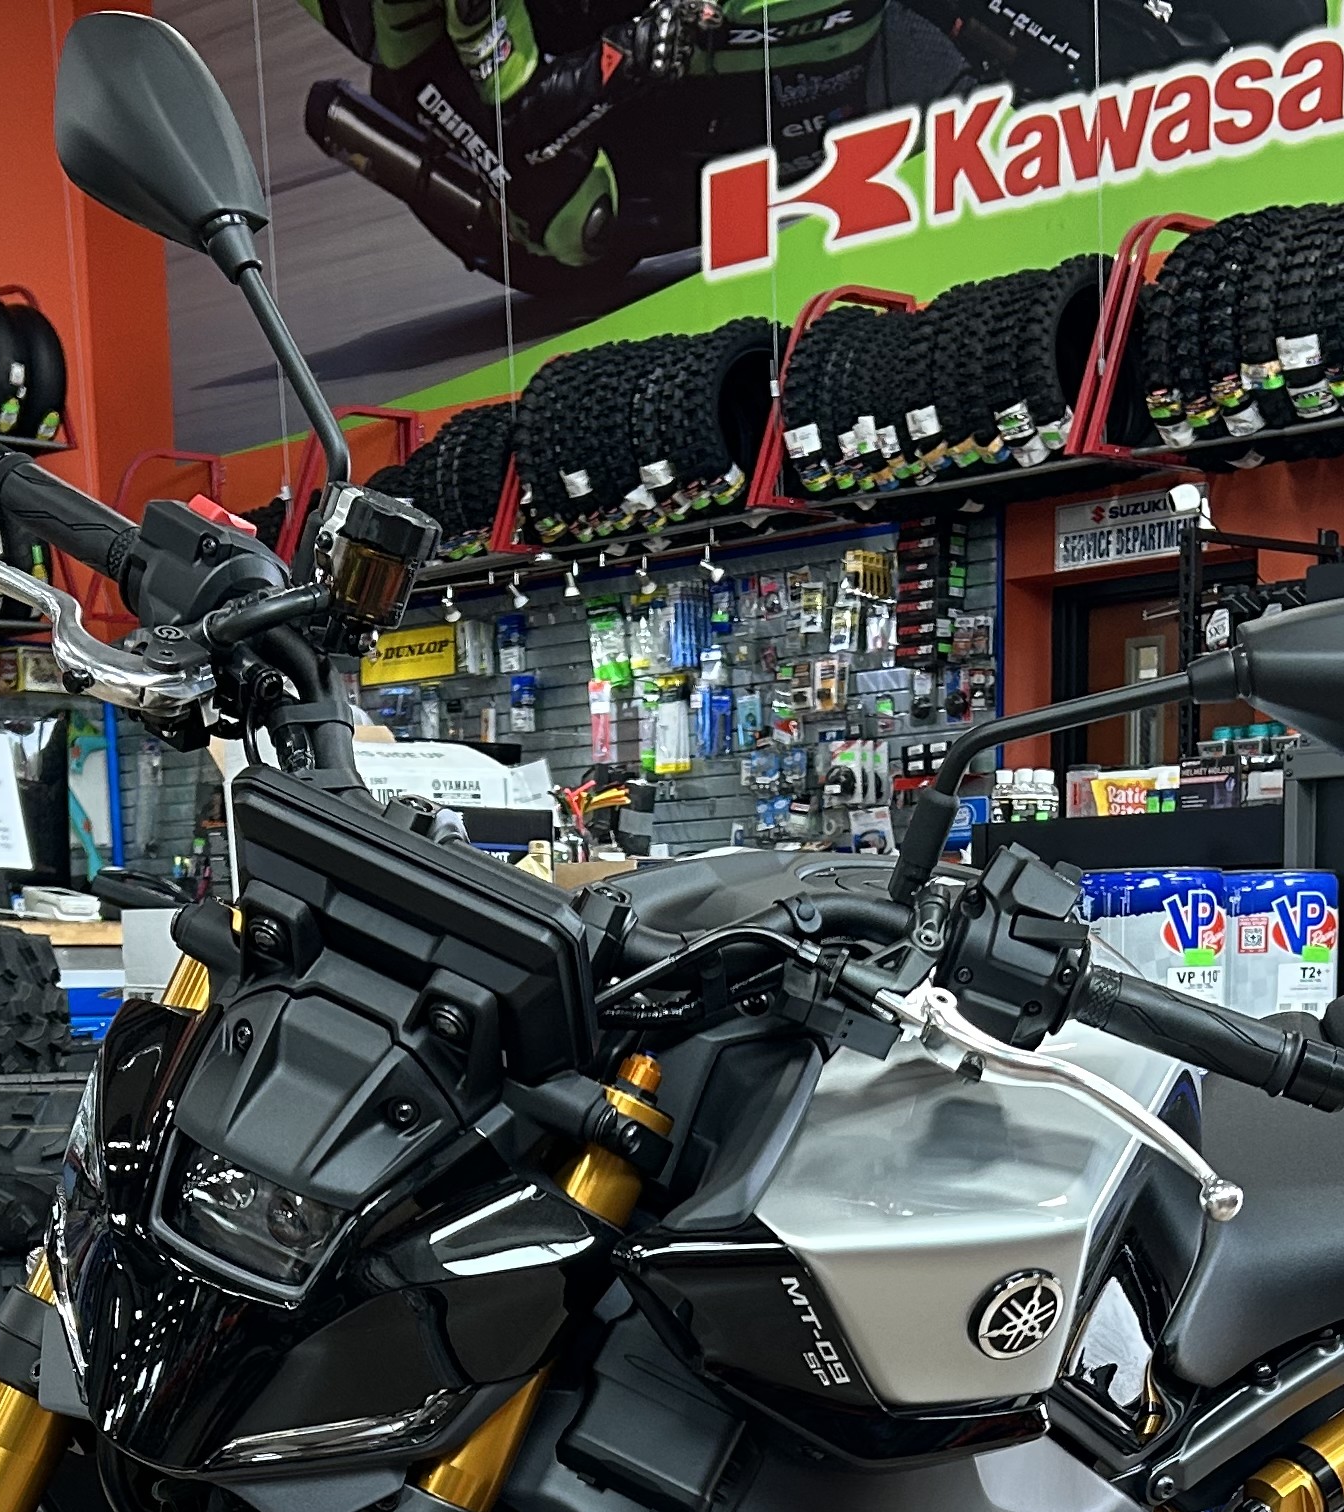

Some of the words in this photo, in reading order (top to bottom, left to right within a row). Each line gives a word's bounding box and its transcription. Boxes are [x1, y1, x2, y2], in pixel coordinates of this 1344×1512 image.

[728, 10, 854, 44] ZX-10R
[988, 0, 1080, 60] PIRELLI
[417, 83, 512, 188] DAINESE
[781, 115, 827, 138] elf
[1108, 500, 1167, 519] SUZUKI
[382, 640, 450, 660] DUNLOP
[378, 751, 416, 759] SIDE
[420, 752, 446, 760] UP
[442, 780, 481, 791] YAMAHA
[1162, 889, 1218, 953] VP
[1271, 890, 1327, 955] VP
[1176, 972, 1196, 984] VP
[1300, 967, 1323, 979] T2+
[781, 1277, 851, 1384] MT-09
[803, 1352, 831, 1386] SP
